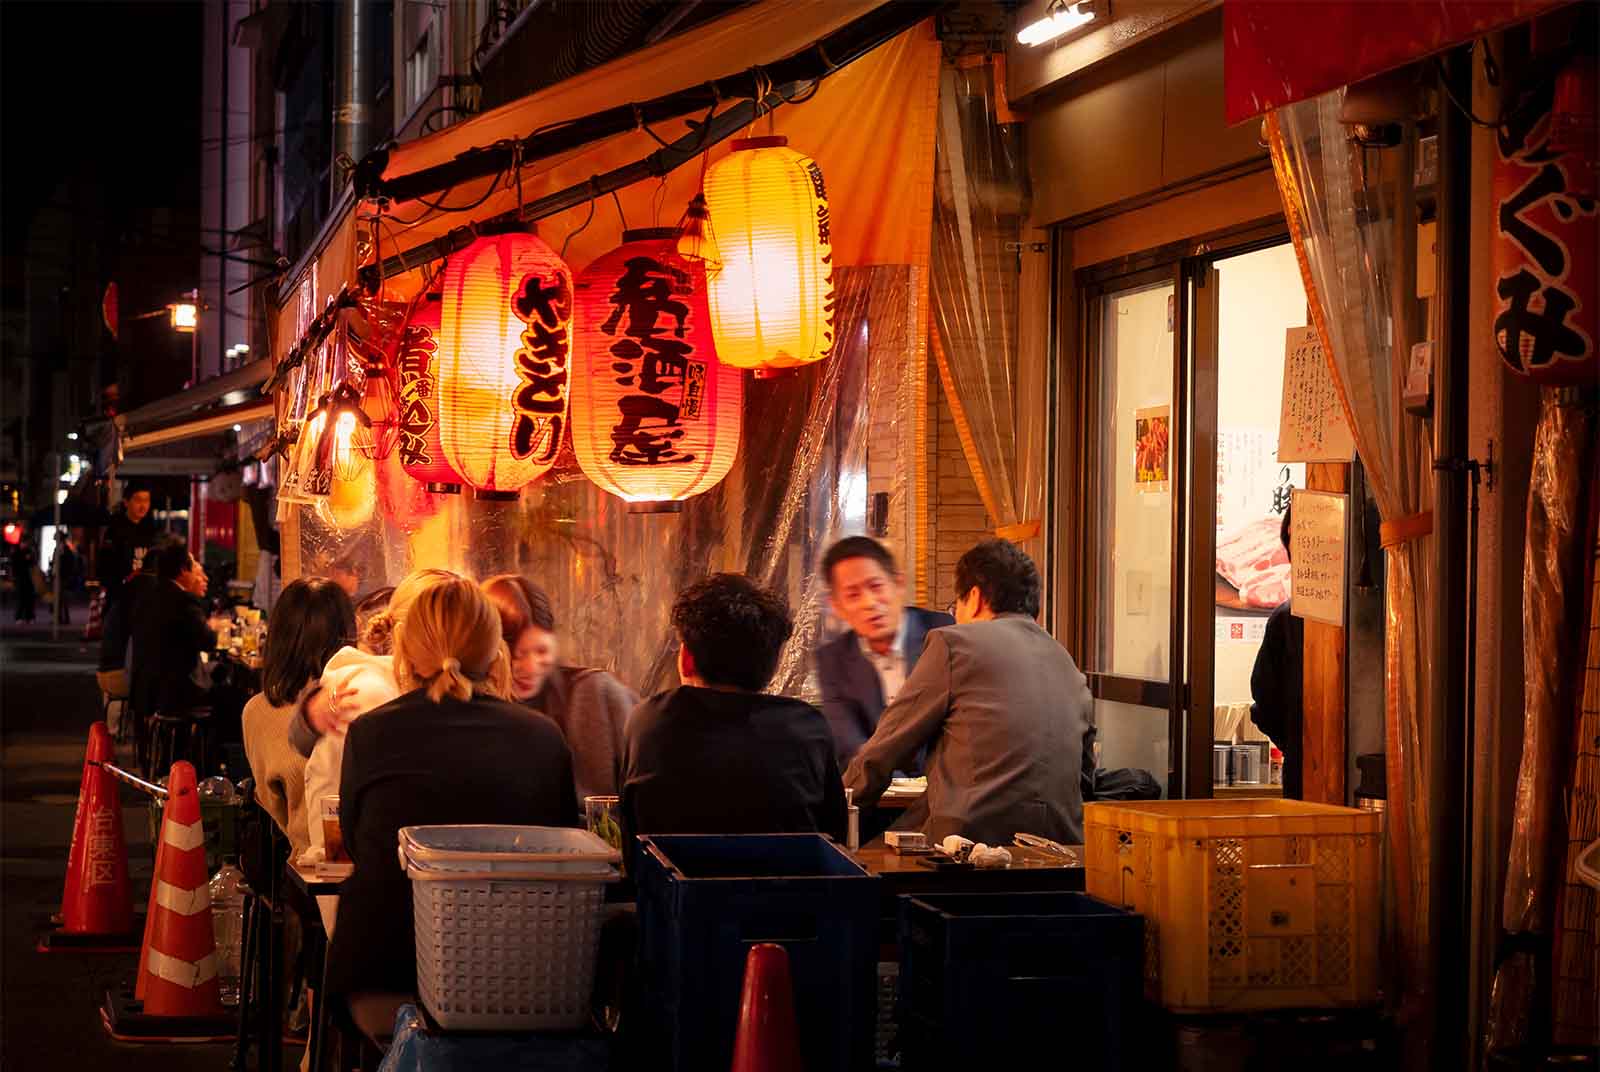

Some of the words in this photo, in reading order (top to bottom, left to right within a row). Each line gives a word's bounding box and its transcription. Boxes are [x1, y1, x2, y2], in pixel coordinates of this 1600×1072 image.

[510, 271, 571, 466] やきとり
[601, 256, 694, 466] 居酒屋
